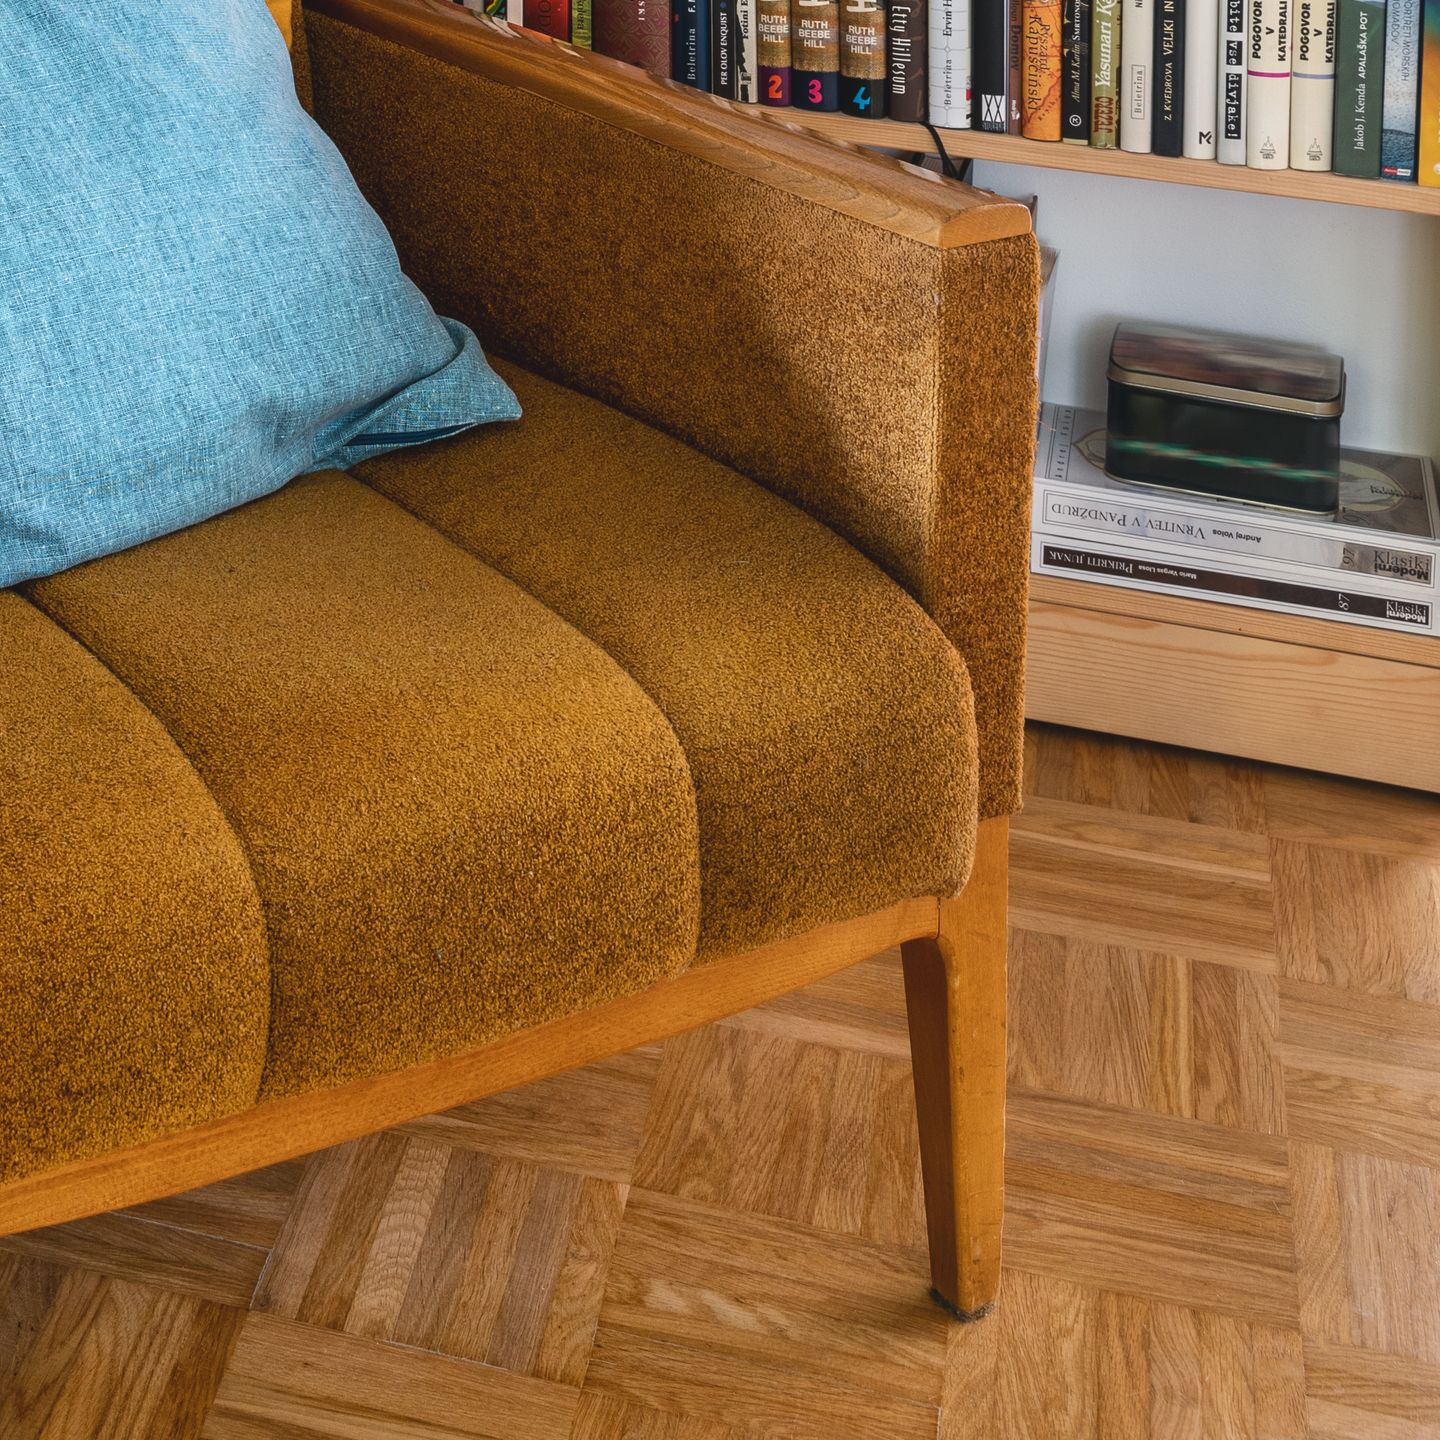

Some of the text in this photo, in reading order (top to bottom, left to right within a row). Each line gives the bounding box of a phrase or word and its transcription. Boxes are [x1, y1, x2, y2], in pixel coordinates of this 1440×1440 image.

[801, 19, 829, 30] RUTH
[1252, 1, 1263, 59] POGOVOR
[1265, 26, 1274, 36] V
[1277, 1, 1287, 61] KATEDRALI
[799, 28, 831, 40] BEEBE
[803, 39, 826, 49] HILL
[768, 75, 783, 98] 2
[808, 79, 822, 103] 3
[1131, 518, 1142, 528] V
[1146, 518, 1205, 539] VRNITEV
[1212, 529, 1261, 542] Andrej Volos
